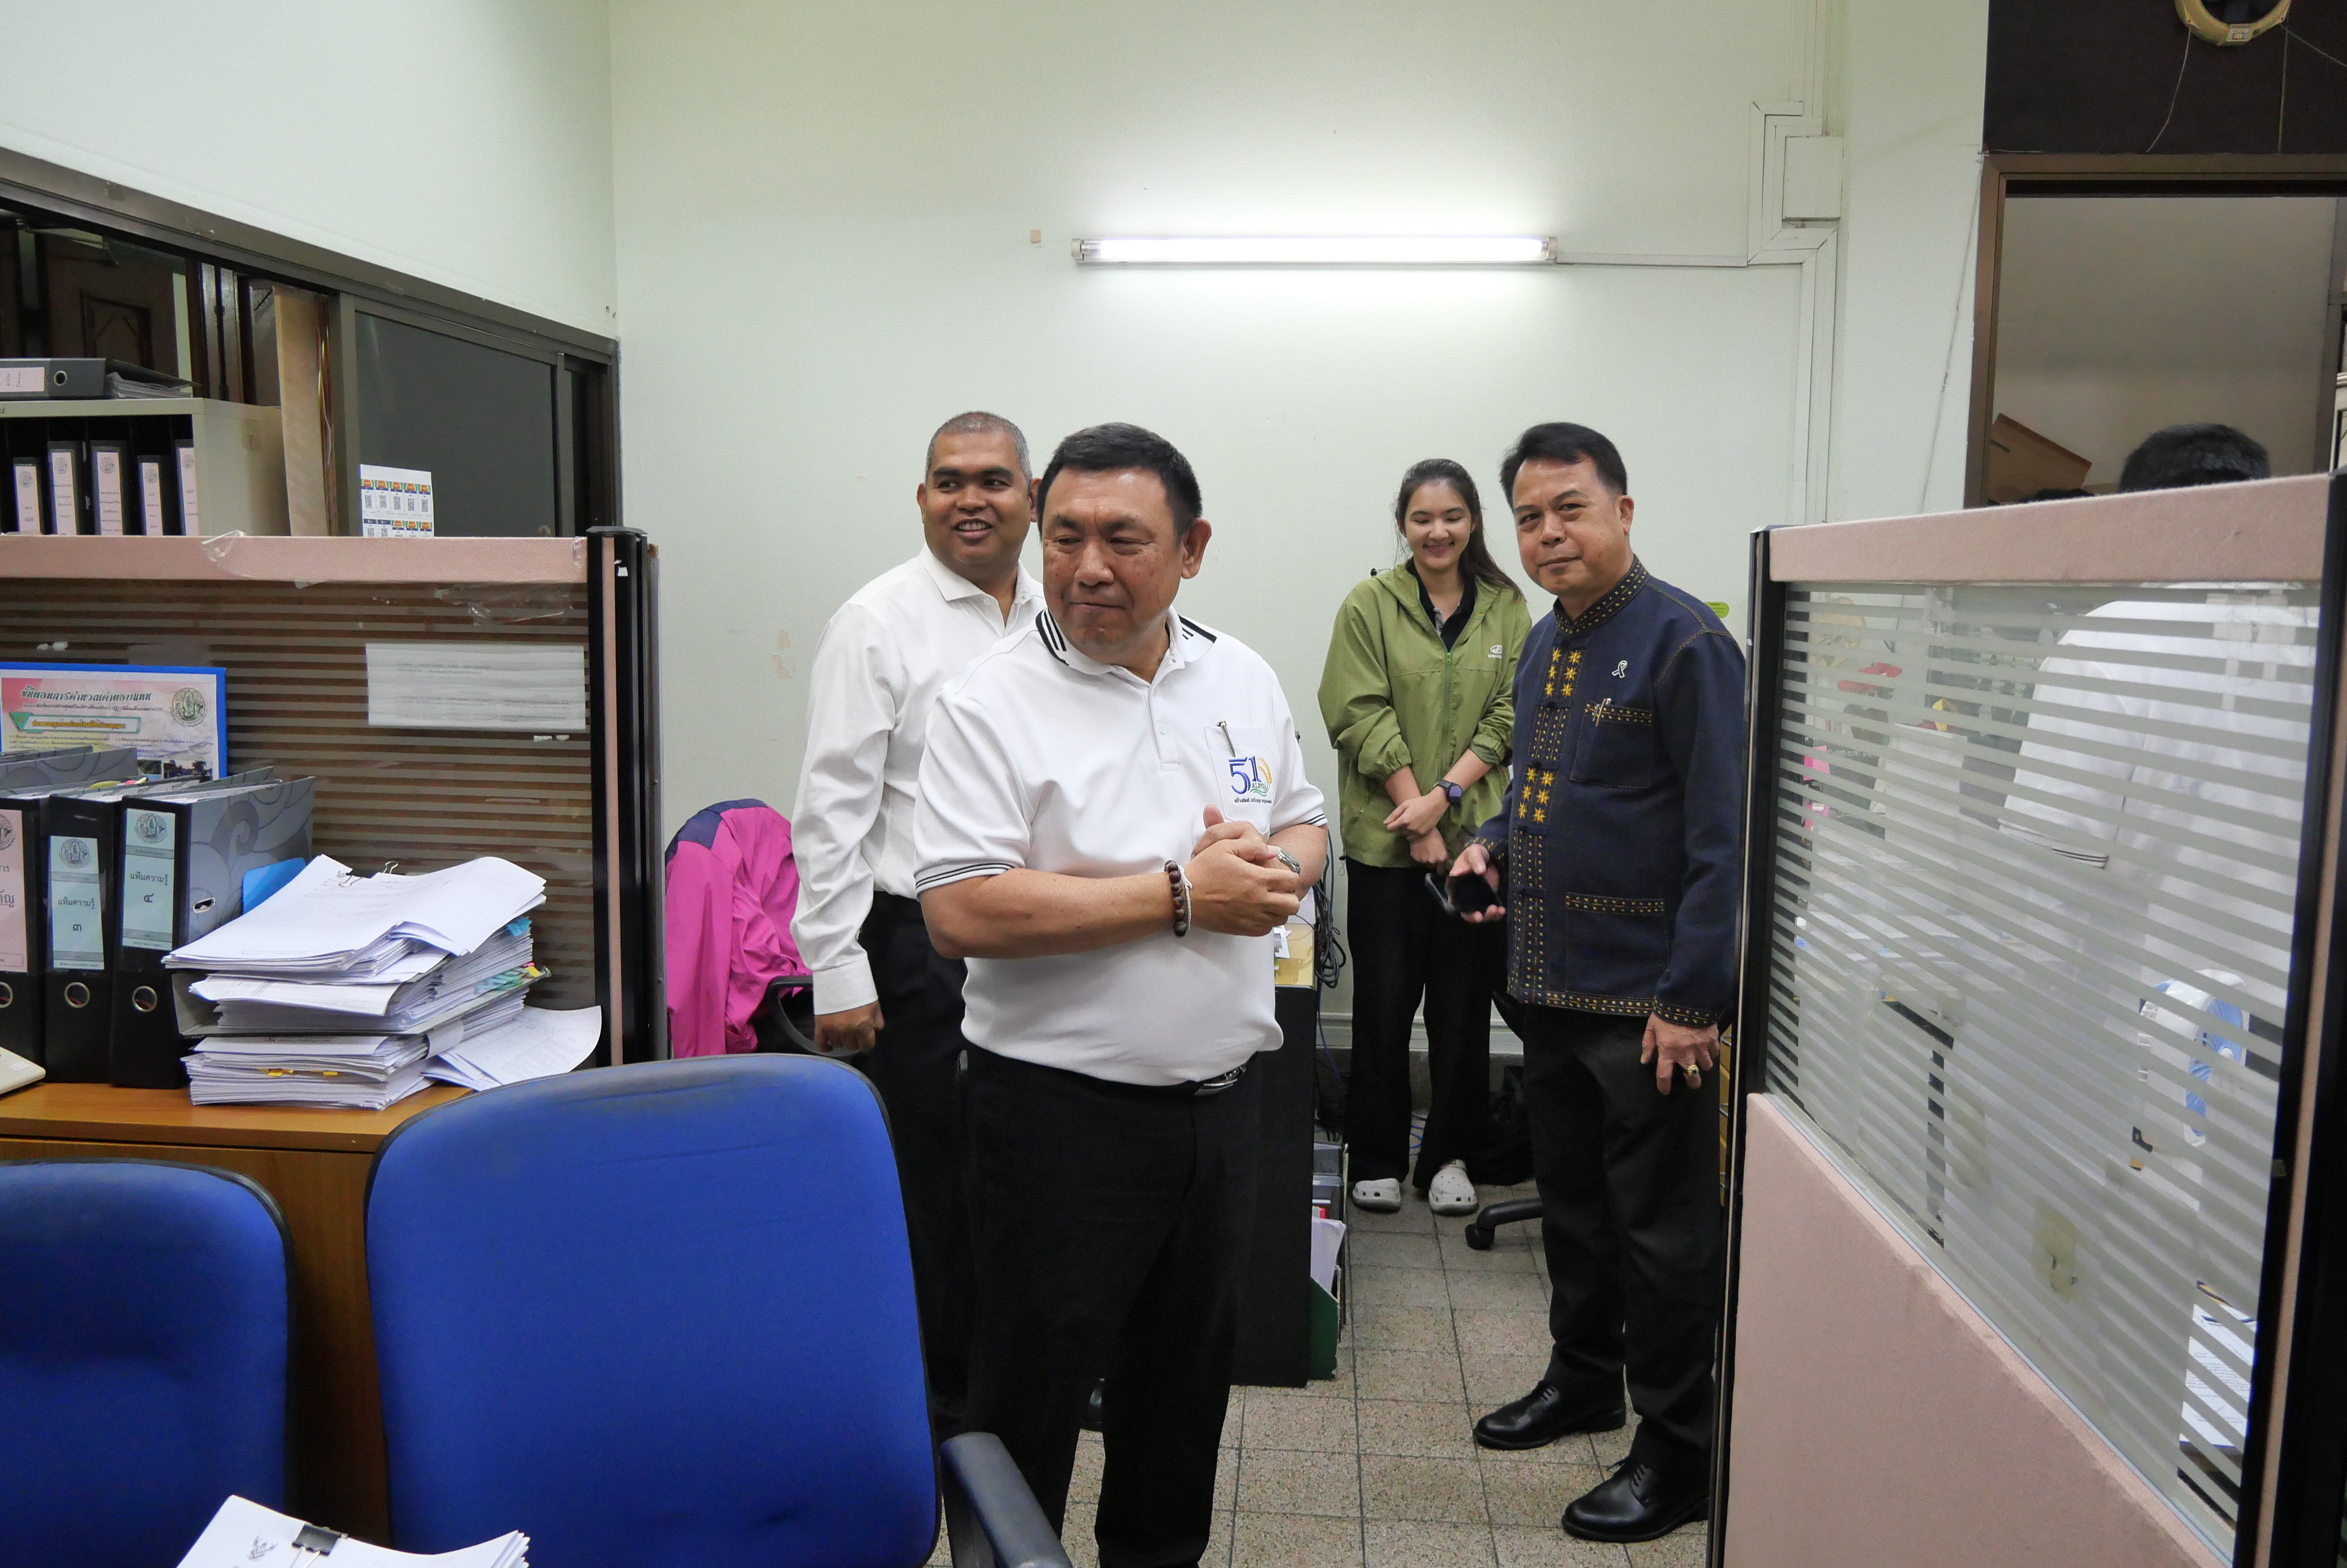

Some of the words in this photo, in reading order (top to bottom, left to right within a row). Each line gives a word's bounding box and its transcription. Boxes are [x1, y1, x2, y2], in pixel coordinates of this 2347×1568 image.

[130, 871, 168, 886] แฟ้มความรู้
[144, 893, 154, 903] ๔
[58, 898, 95, 909] แฟ้มความรู้
[73, 922, 82, 931] ๓
